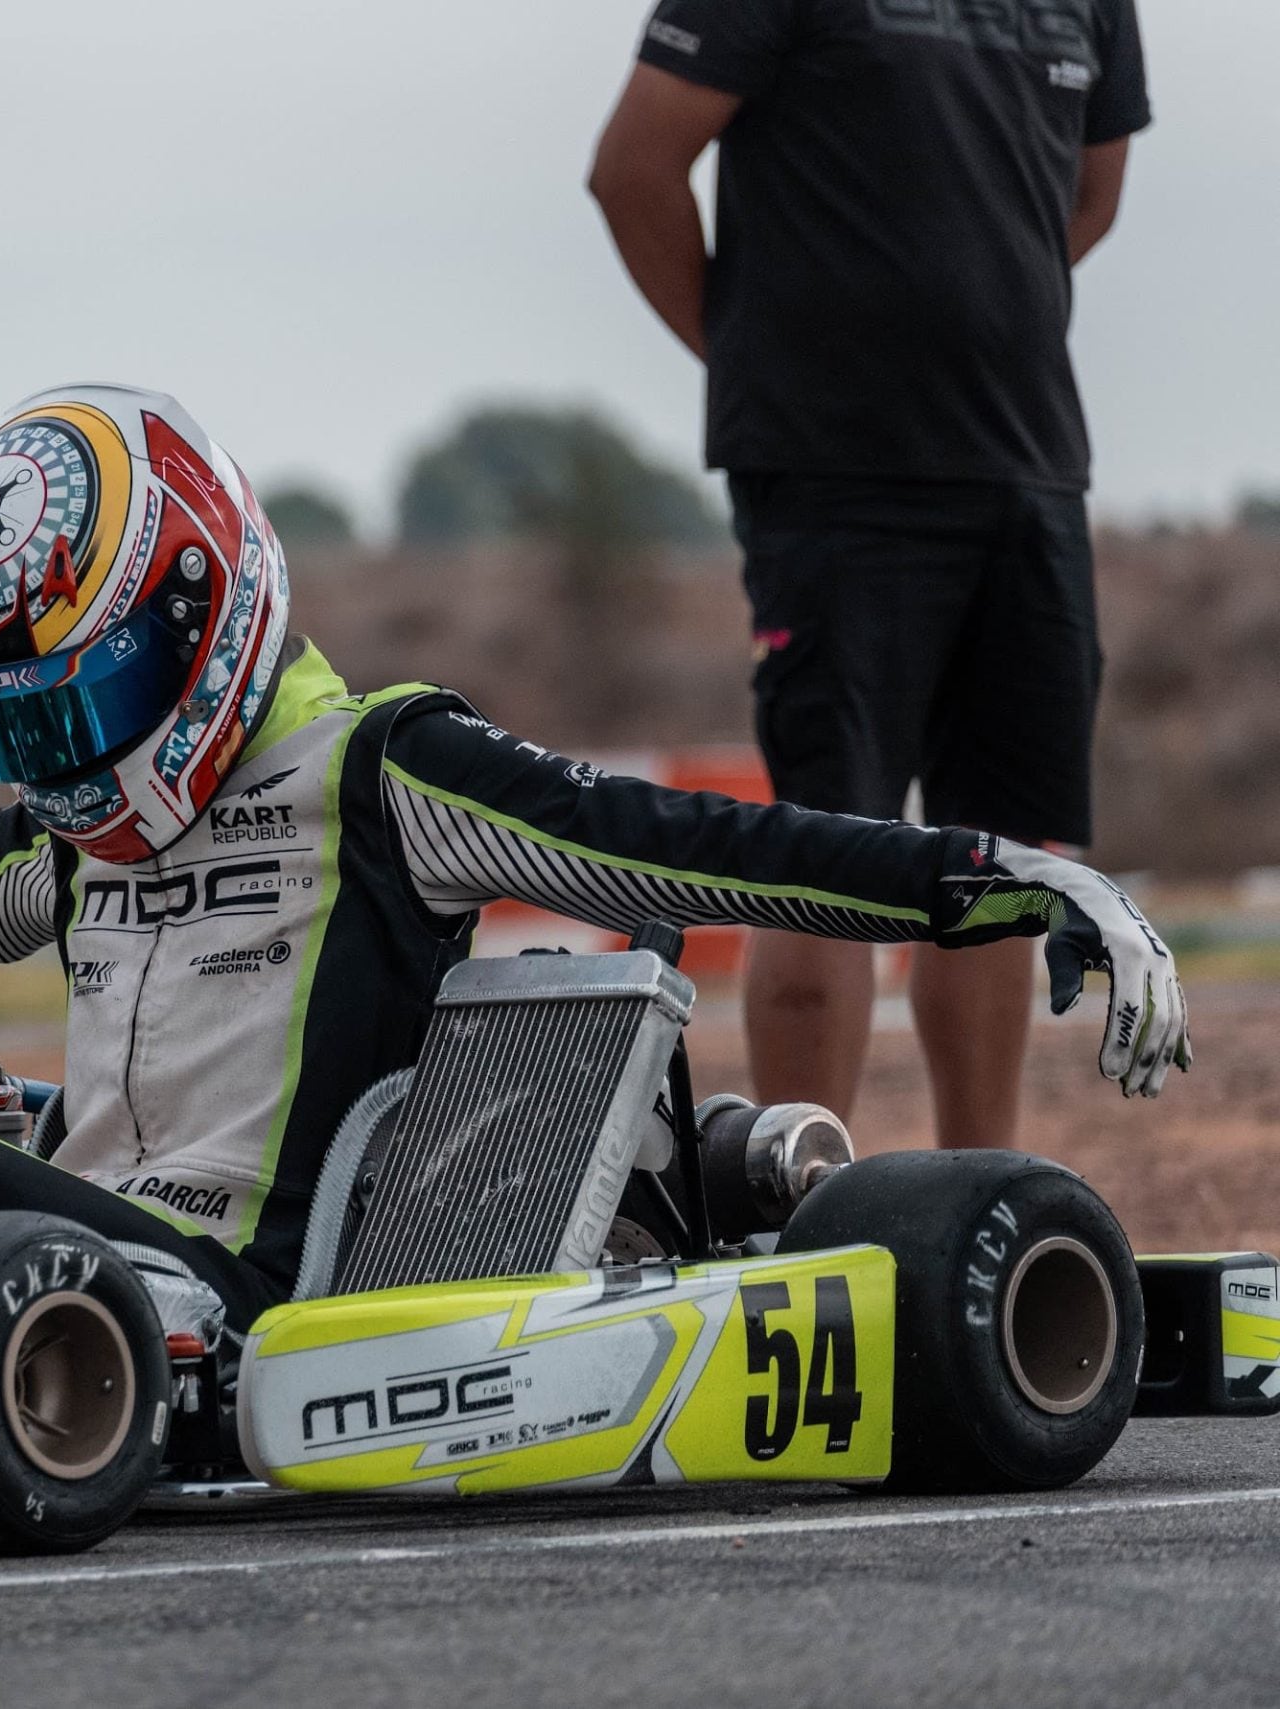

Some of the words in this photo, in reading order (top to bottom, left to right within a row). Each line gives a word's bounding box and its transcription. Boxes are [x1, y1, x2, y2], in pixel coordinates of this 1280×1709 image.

[75, 487, 84, 498] 25
[70, 513, 80, 523] 34
[161, 731, 186, 780] 777
[210, 805, 293, 830] KART
[212, 825, 297, 845] REPUBLIC
[78, 859, 281, 925] MDC
[239, 875, 314, 892] racing
[189, 948, 264, 967] E.Leclerc
[198, 963, 261, 976] ANDORRA
[138, 1176, 232, 1220] GARCÍA
[1228, 1283, 1270, 1299] MDC
[739, 1275, 862, 1461] 54
[302, 1366, 514, 1441] MDC
[482, 1375, 533, 1396] racing
